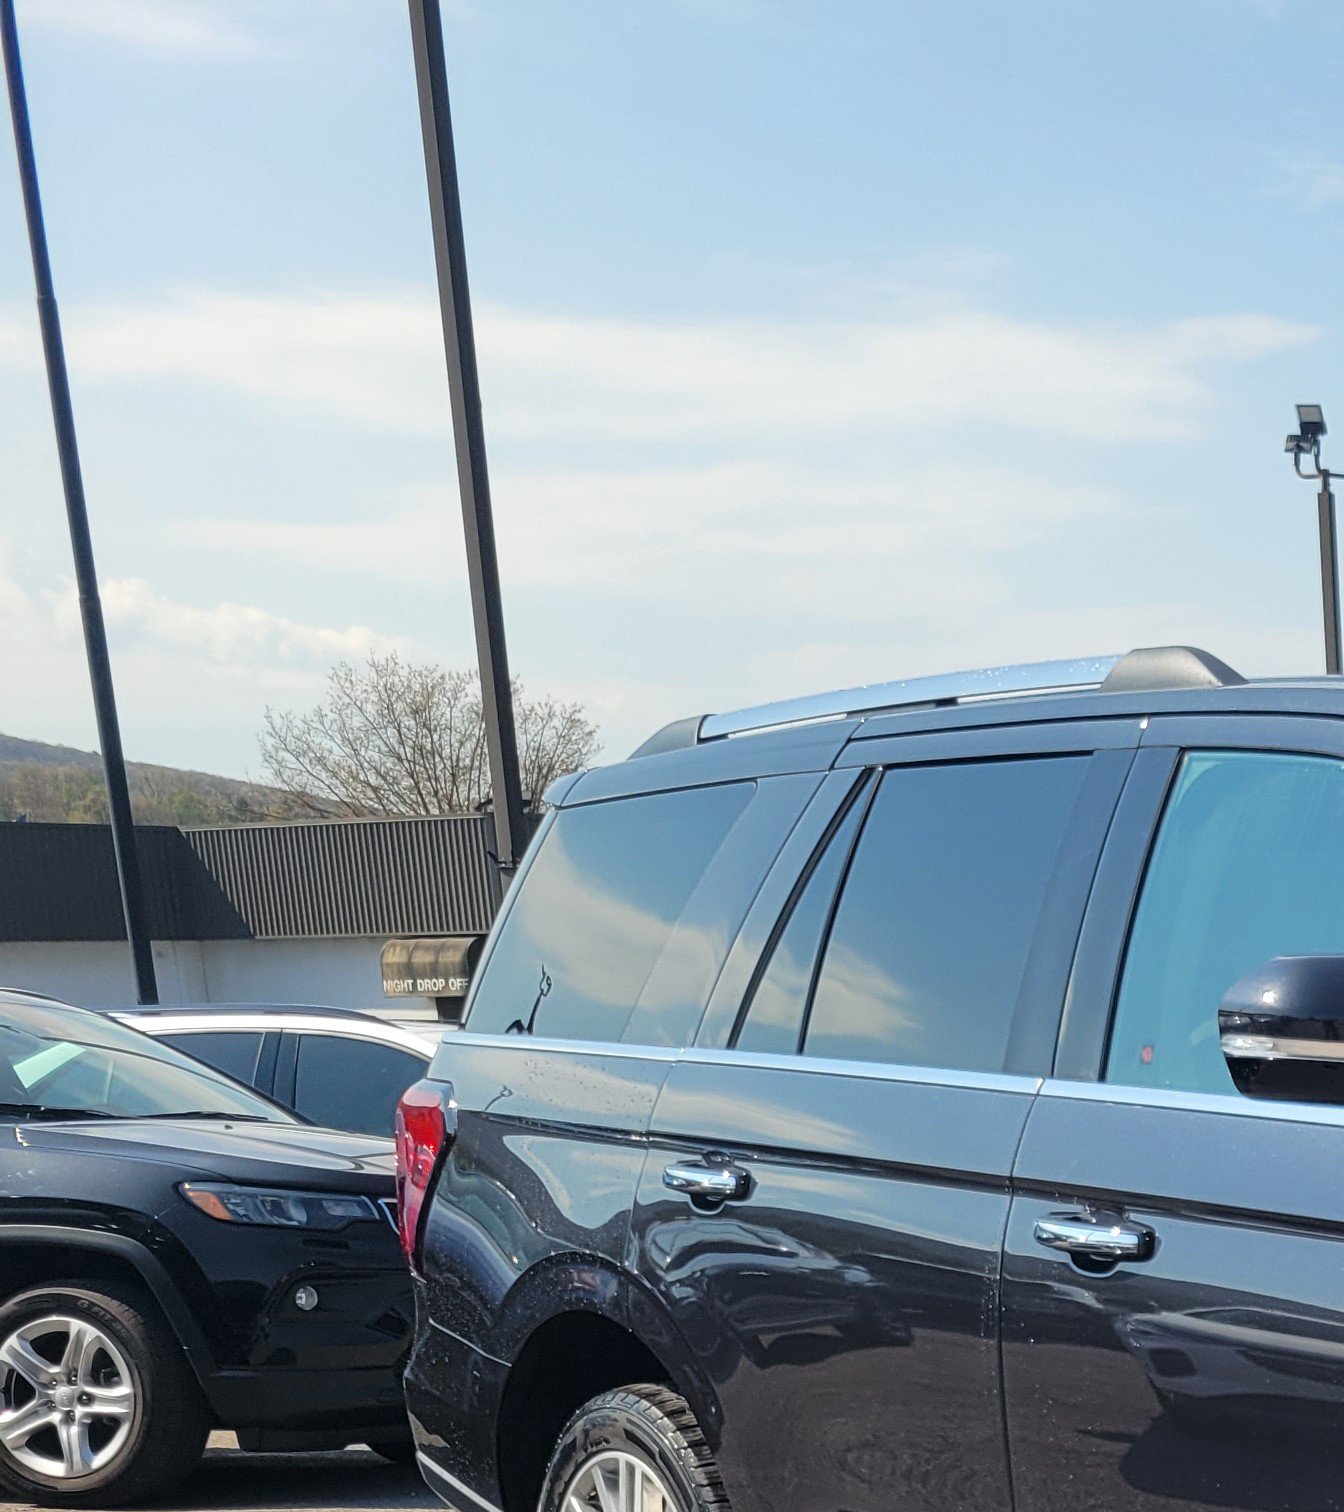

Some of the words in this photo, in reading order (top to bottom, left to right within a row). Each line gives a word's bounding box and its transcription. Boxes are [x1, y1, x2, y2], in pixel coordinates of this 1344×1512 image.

[383, 979, 413, 992] NIGHT
[417, 979, 445, 992] DROP
[449, 978, 469, 991] OFF
